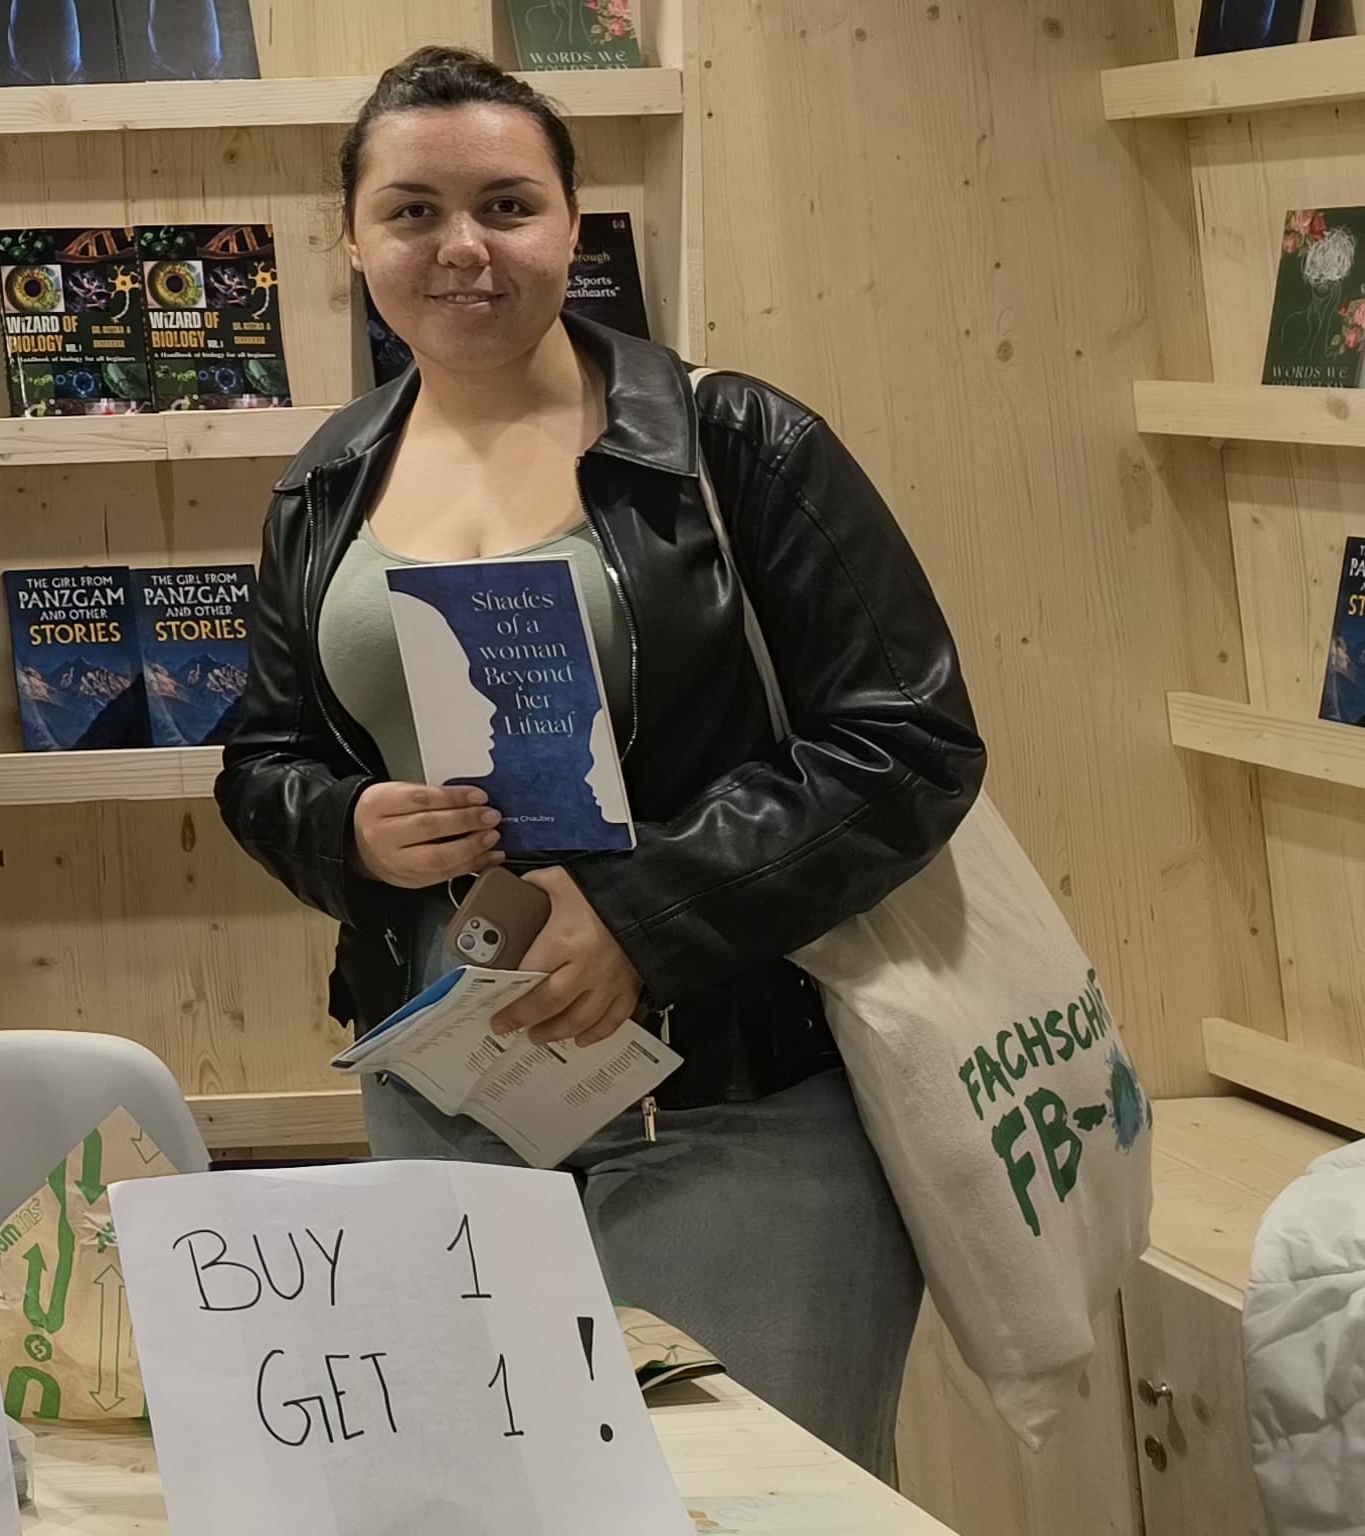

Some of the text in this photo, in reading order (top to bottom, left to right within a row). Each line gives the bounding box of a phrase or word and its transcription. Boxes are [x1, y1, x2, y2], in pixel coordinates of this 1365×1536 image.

[529, 50, 592, 64] WORDS
[63, 316, 78, 332] OF
[204, 311, 220, 328] OF
[9, 335, 63, 353] BIOLOGY
[151, 330, 205, 348] BIOLOGY
[27, 576, 113, 589] THE GIRL FROM
[151, 572, 237, 585] THE GIRL FROM
[19, 587, 125, 609] PANZGAM
[144, 584, 249, 606] PANZGAM
[471, 590, 555, 612] Shades
[40, 608, 107, 621] AND OTHER
[166, 605, 233, 617] AND OTHER
[30, 622, 121, 645] STORIES
[155, 619, 247, 642] STORIES
[497, 613, 540, 637] of a
[478, 642, 568, 660] woman
[485, 664, 573, 693] Beyond
[514, 686, 550, 711] her
[504, 712, 577, 737] Lihaaf
[173, 1227, 344, 1312] BUY
[447, 1214, 492, 1299] 1
[257, 1349, 398, 1447] GET
